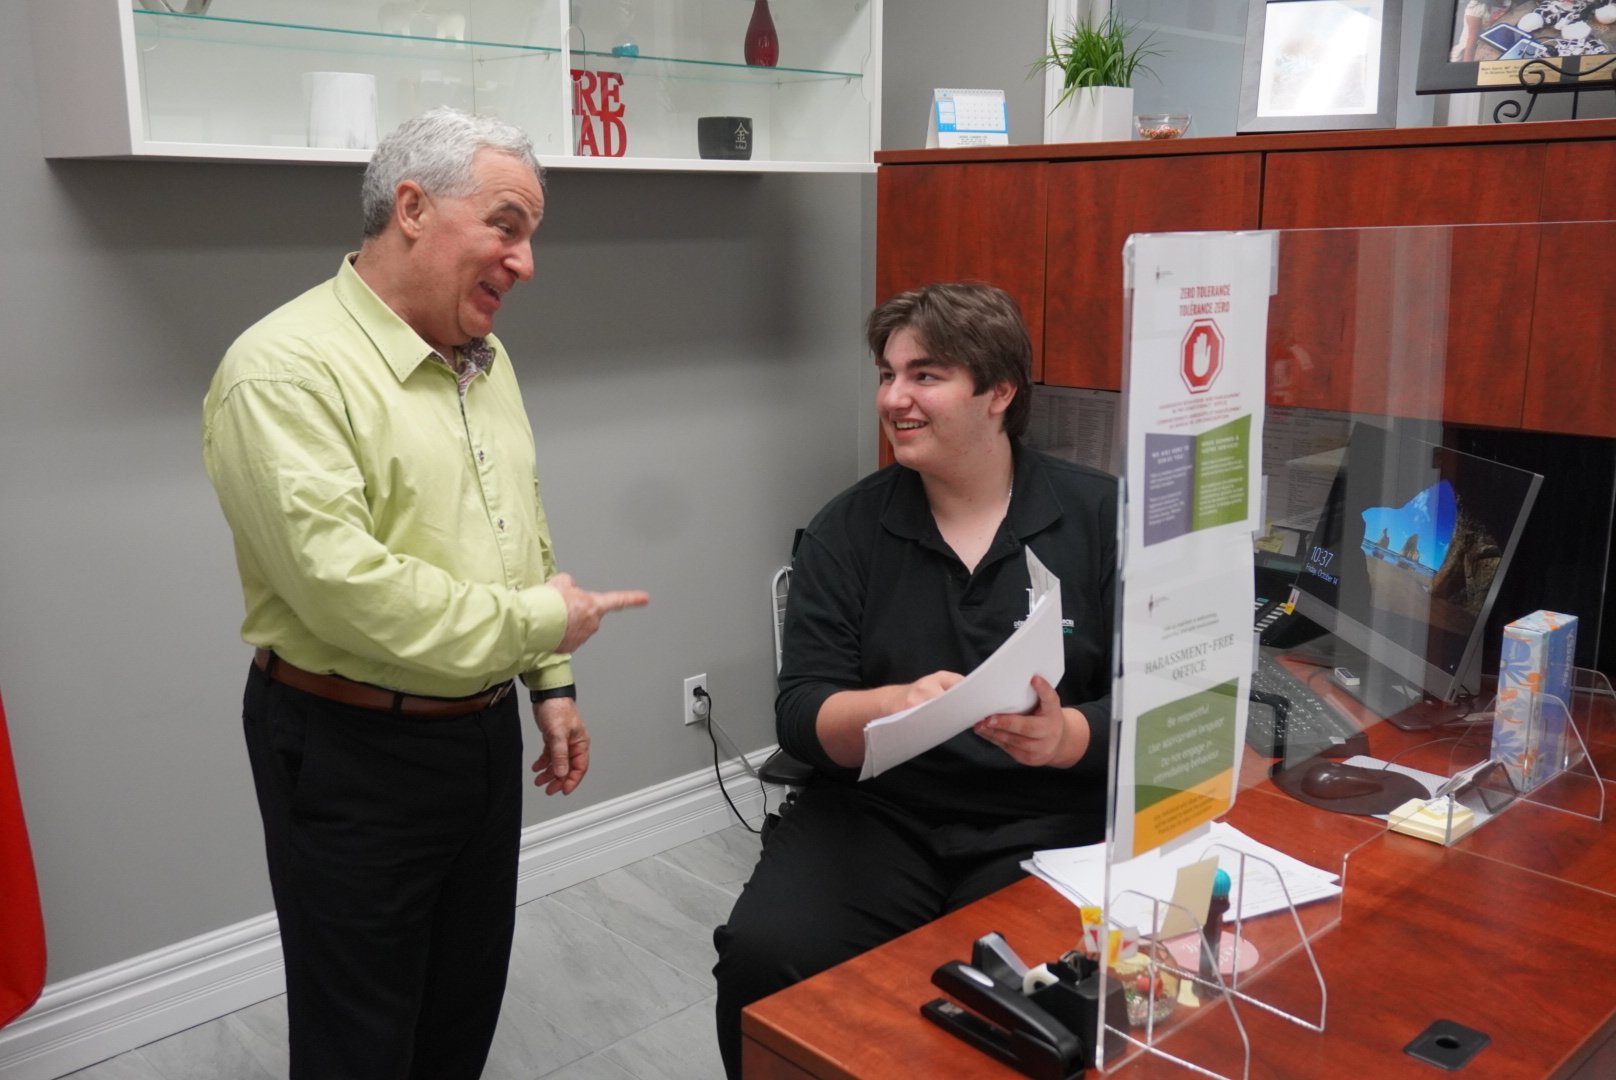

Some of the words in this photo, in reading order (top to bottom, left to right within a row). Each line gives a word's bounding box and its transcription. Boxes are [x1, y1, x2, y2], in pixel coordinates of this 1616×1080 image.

[570, 69, 625, 117] RE
[577, 114, 627, 157] AD
[1180, 286, 1195, 299] ZERO
[1196, 285, 1231, 297] TOLERANCE
[1311, 546, 1334, 568] 10:37
[1317, 569, 1333, 582] October
[1145, 633, 1235, 674] HARASSMENT-FREE
[1172, 659, 1207, 681] OFFICE
